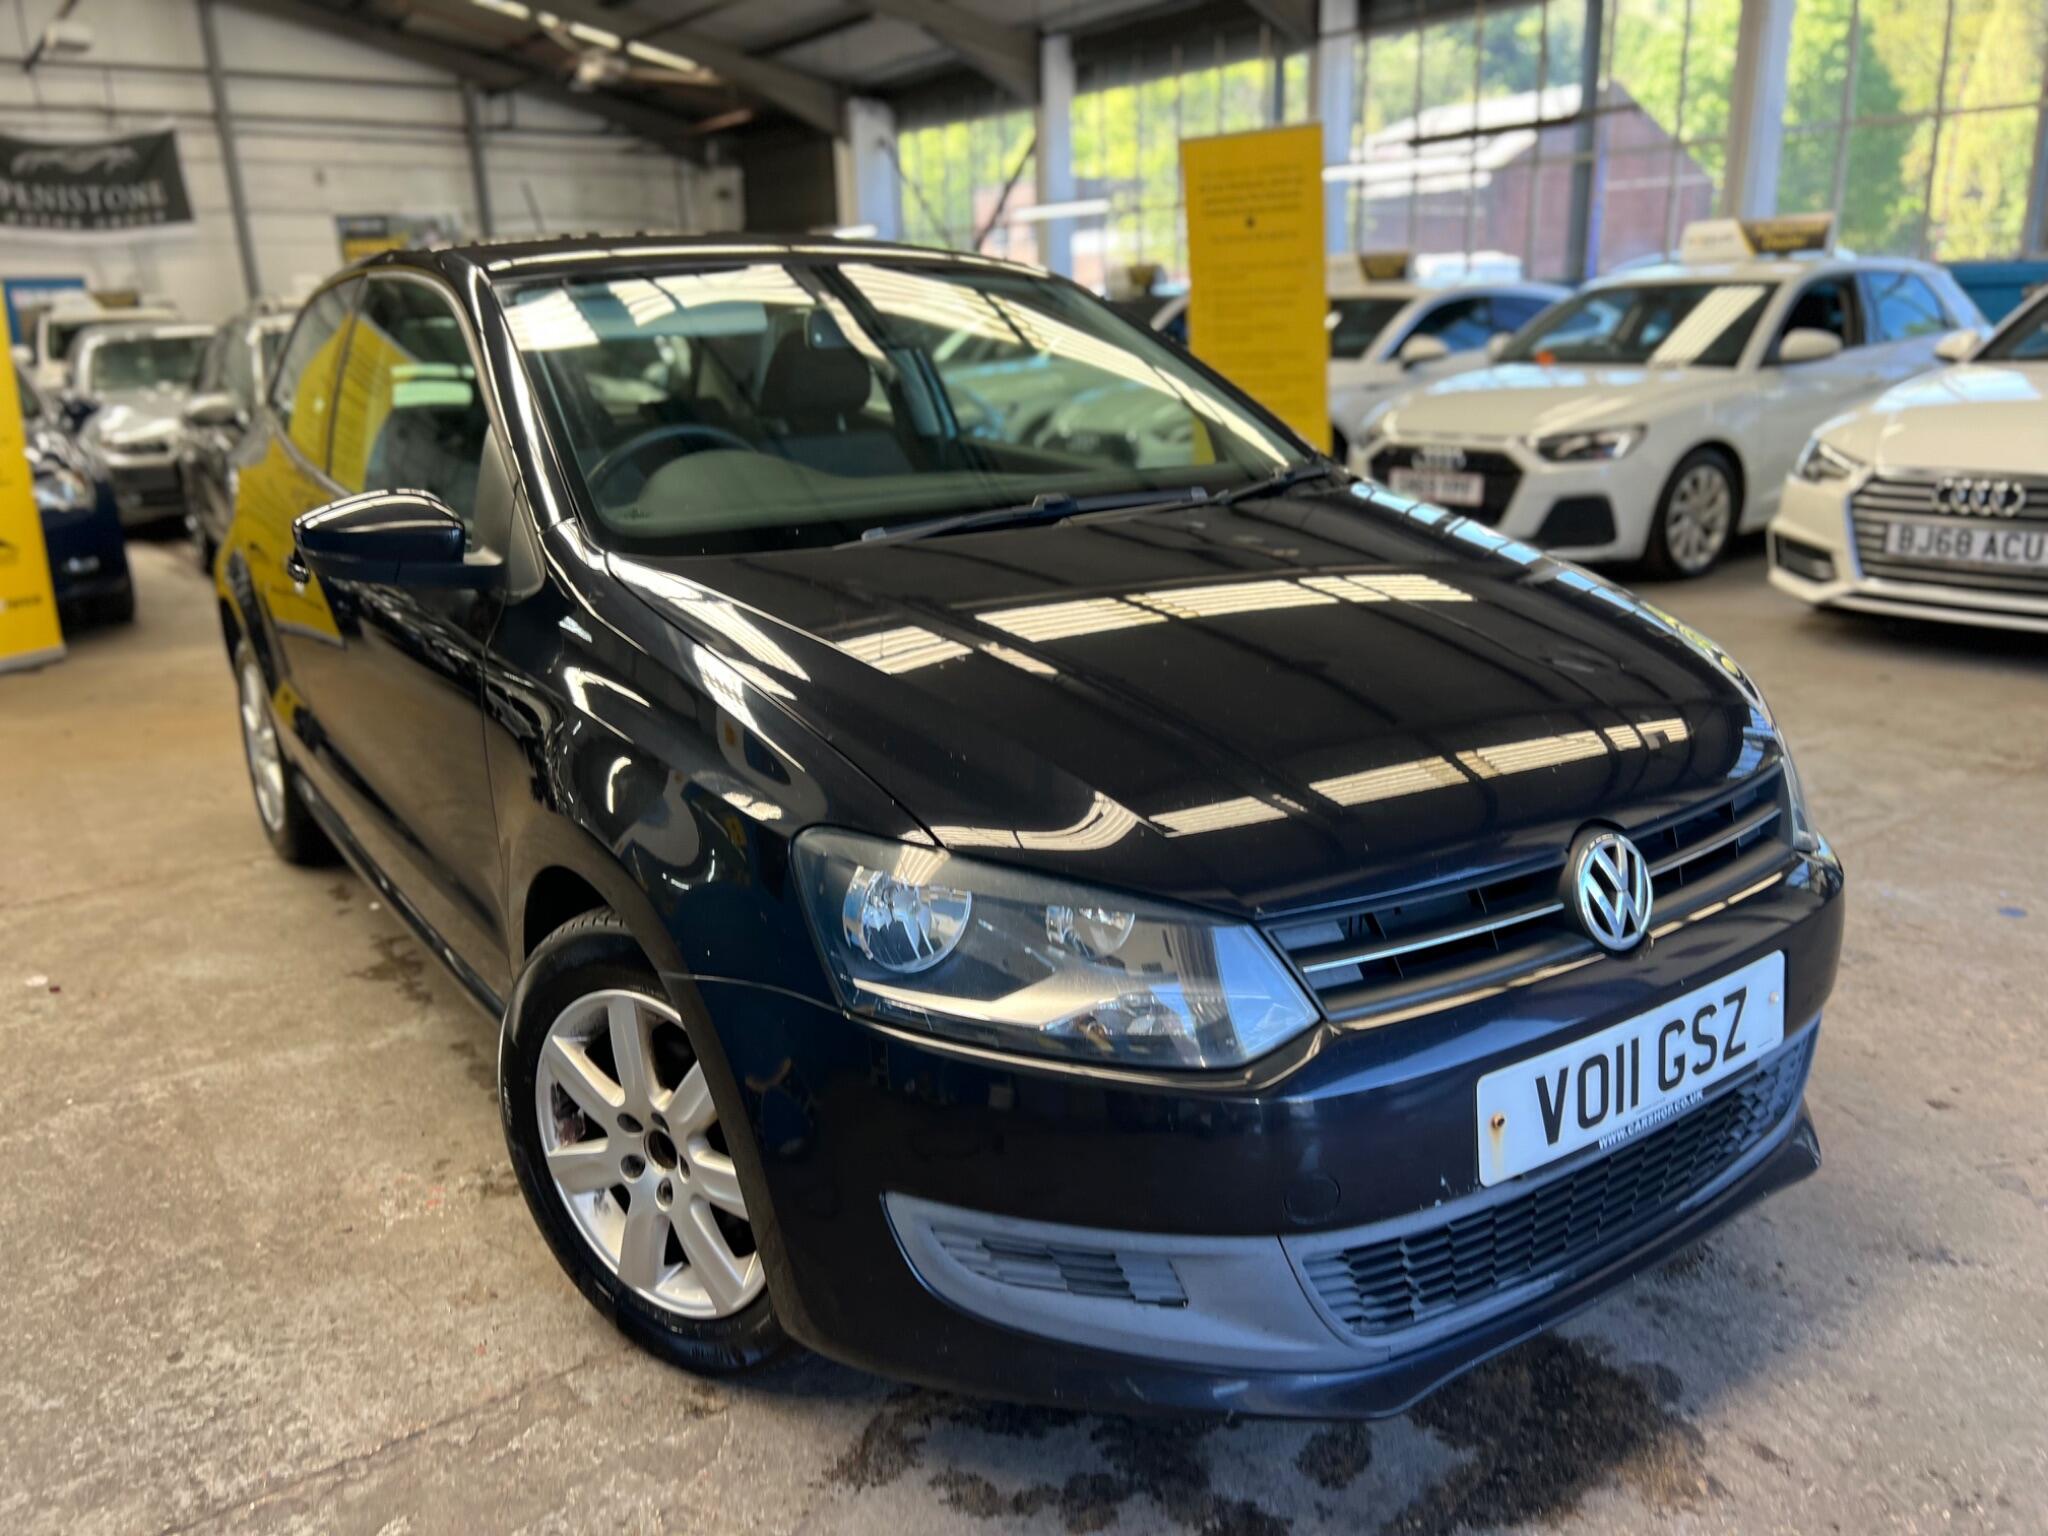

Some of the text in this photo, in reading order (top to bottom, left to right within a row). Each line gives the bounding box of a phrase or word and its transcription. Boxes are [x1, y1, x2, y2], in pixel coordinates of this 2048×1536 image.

[1983, 532, 2045, 562] ACU
[1535, 986, 1747, 1146] VO11 GSZ
